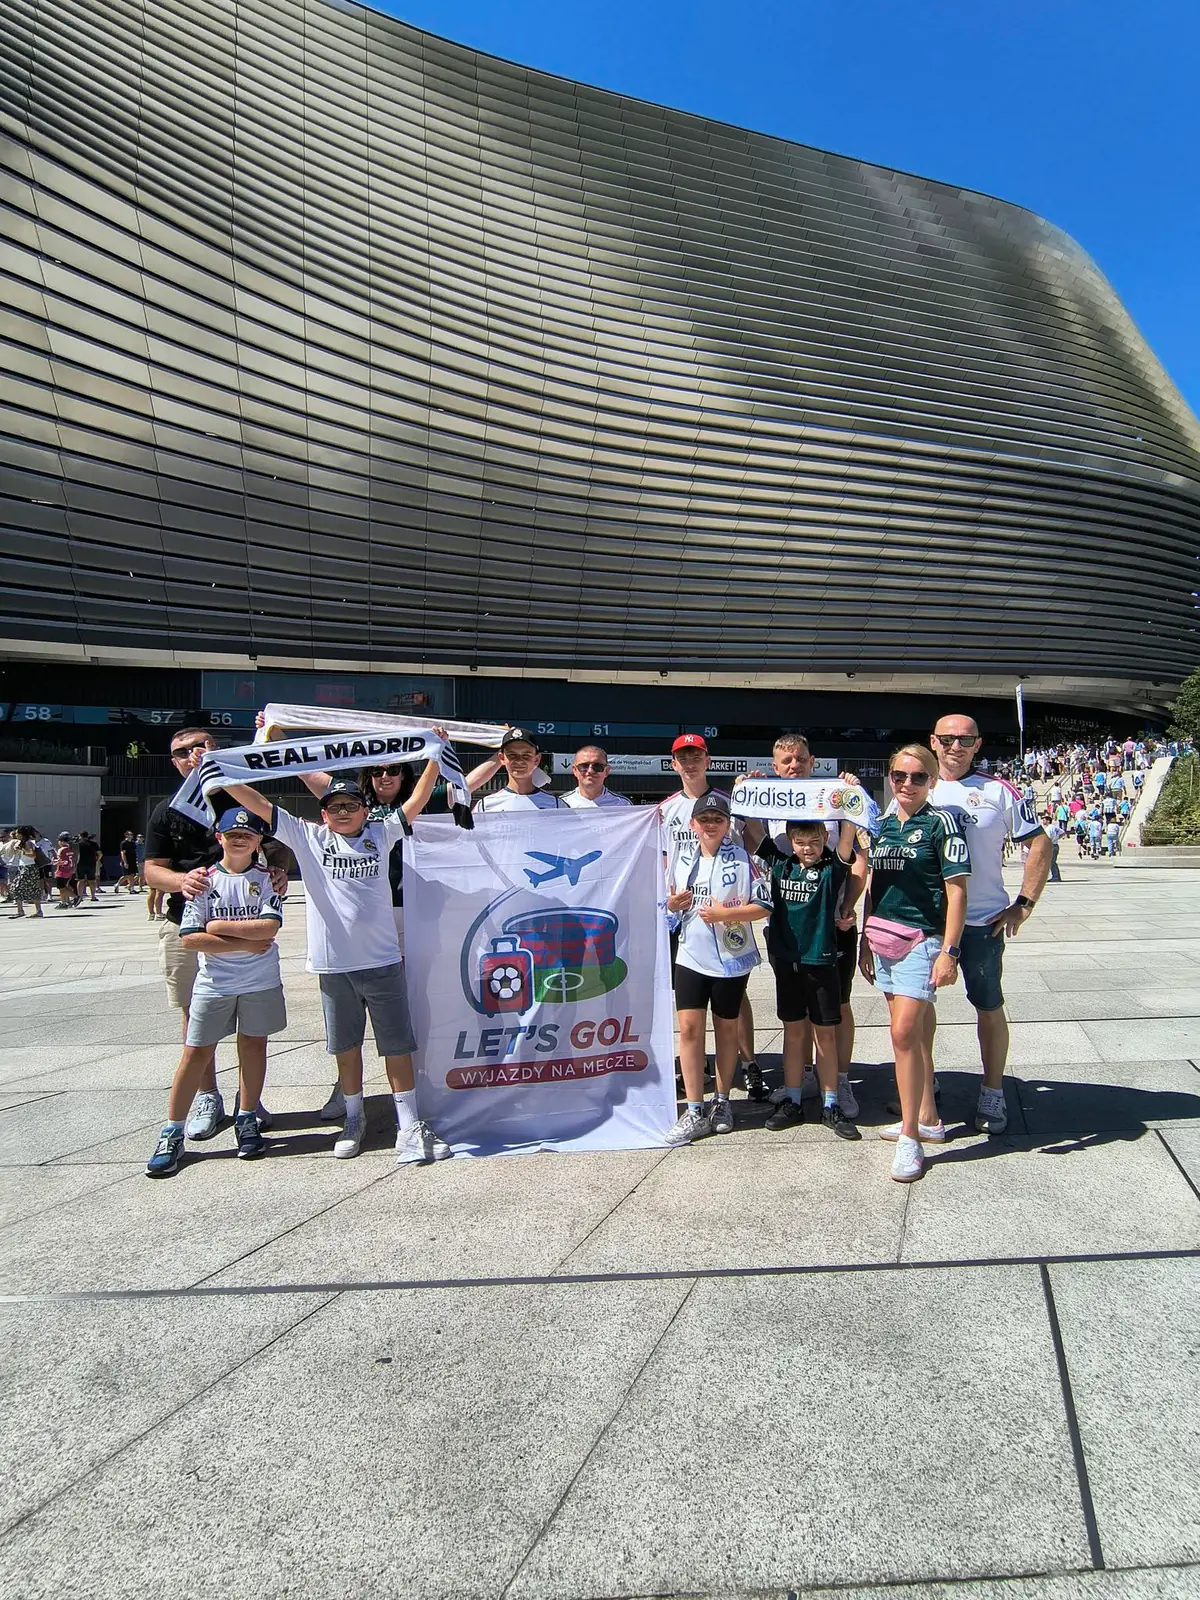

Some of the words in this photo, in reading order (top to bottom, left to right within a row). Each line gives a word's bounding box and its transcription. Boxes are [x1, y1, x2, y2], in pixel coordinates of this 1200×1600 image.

[25, 706, 51, 720] 58
[150, 711, 174, 723] 57
[210, 712, 233, 725] 56
[537, 723, 555, 734] 52
[594, 725, 609, 735] 51
[704, 727, 718, 738] 50
[244, 746, 318, 769] REAL
[324, 737, 426, 760] MADRID
[948, 837, 965, 863] hp
[322, 854, 381, 868] Emirate
[332, 868, 347, 879] FLY
[349, 865, 380, 878] BETTER
[780, 879, 819, 893] mirates
[785, 890, 810, 903] BETTER
[453, 1024, 560, 1060] LET'S
[570, 1016, 641, 1050] GOL
[460, 1066, 544, 1085] WYJAZDY
[551, 1064, 576, 1078] NA
[583, 1054, 636, 1074] MECZE
